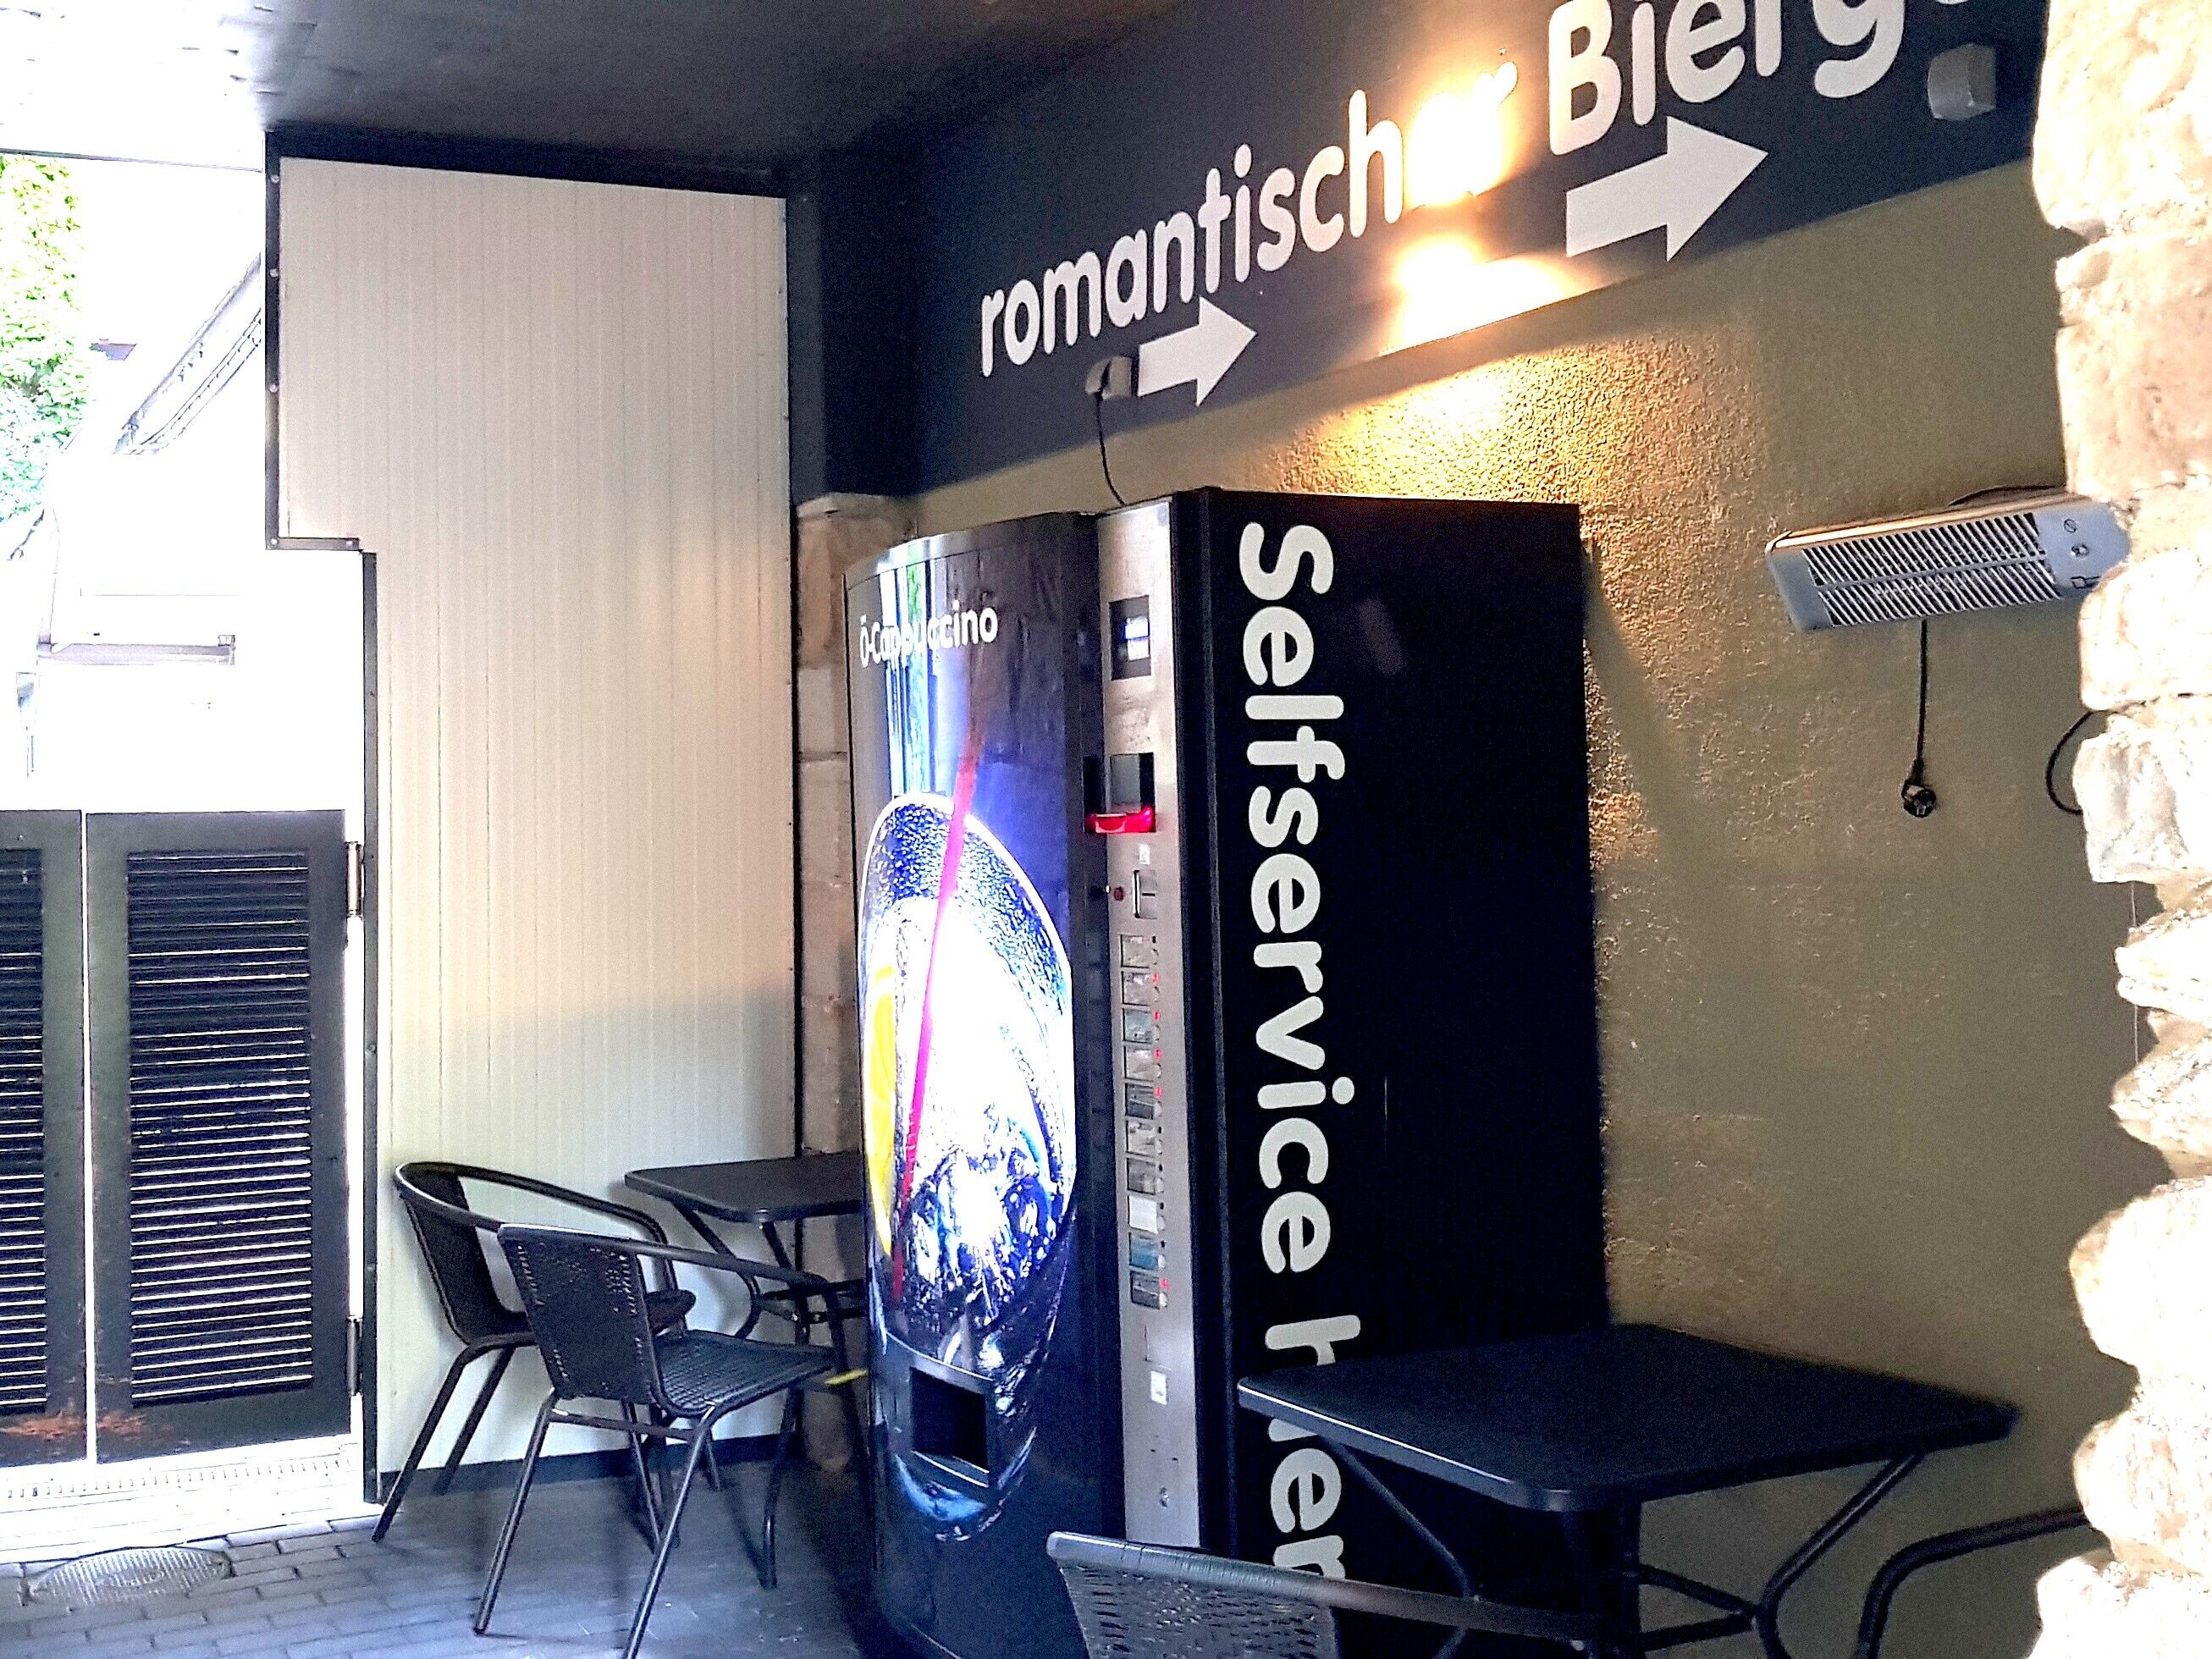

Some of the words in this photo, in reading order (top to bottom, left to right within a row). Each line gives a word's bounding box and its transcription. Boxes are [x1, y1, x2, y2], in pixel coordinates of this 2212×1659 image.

[979, 61, 1518, 378] romantischr
[1238, 522, 1354, 1275] Selfservice
[1265, 1315, 1360, 1579] her
